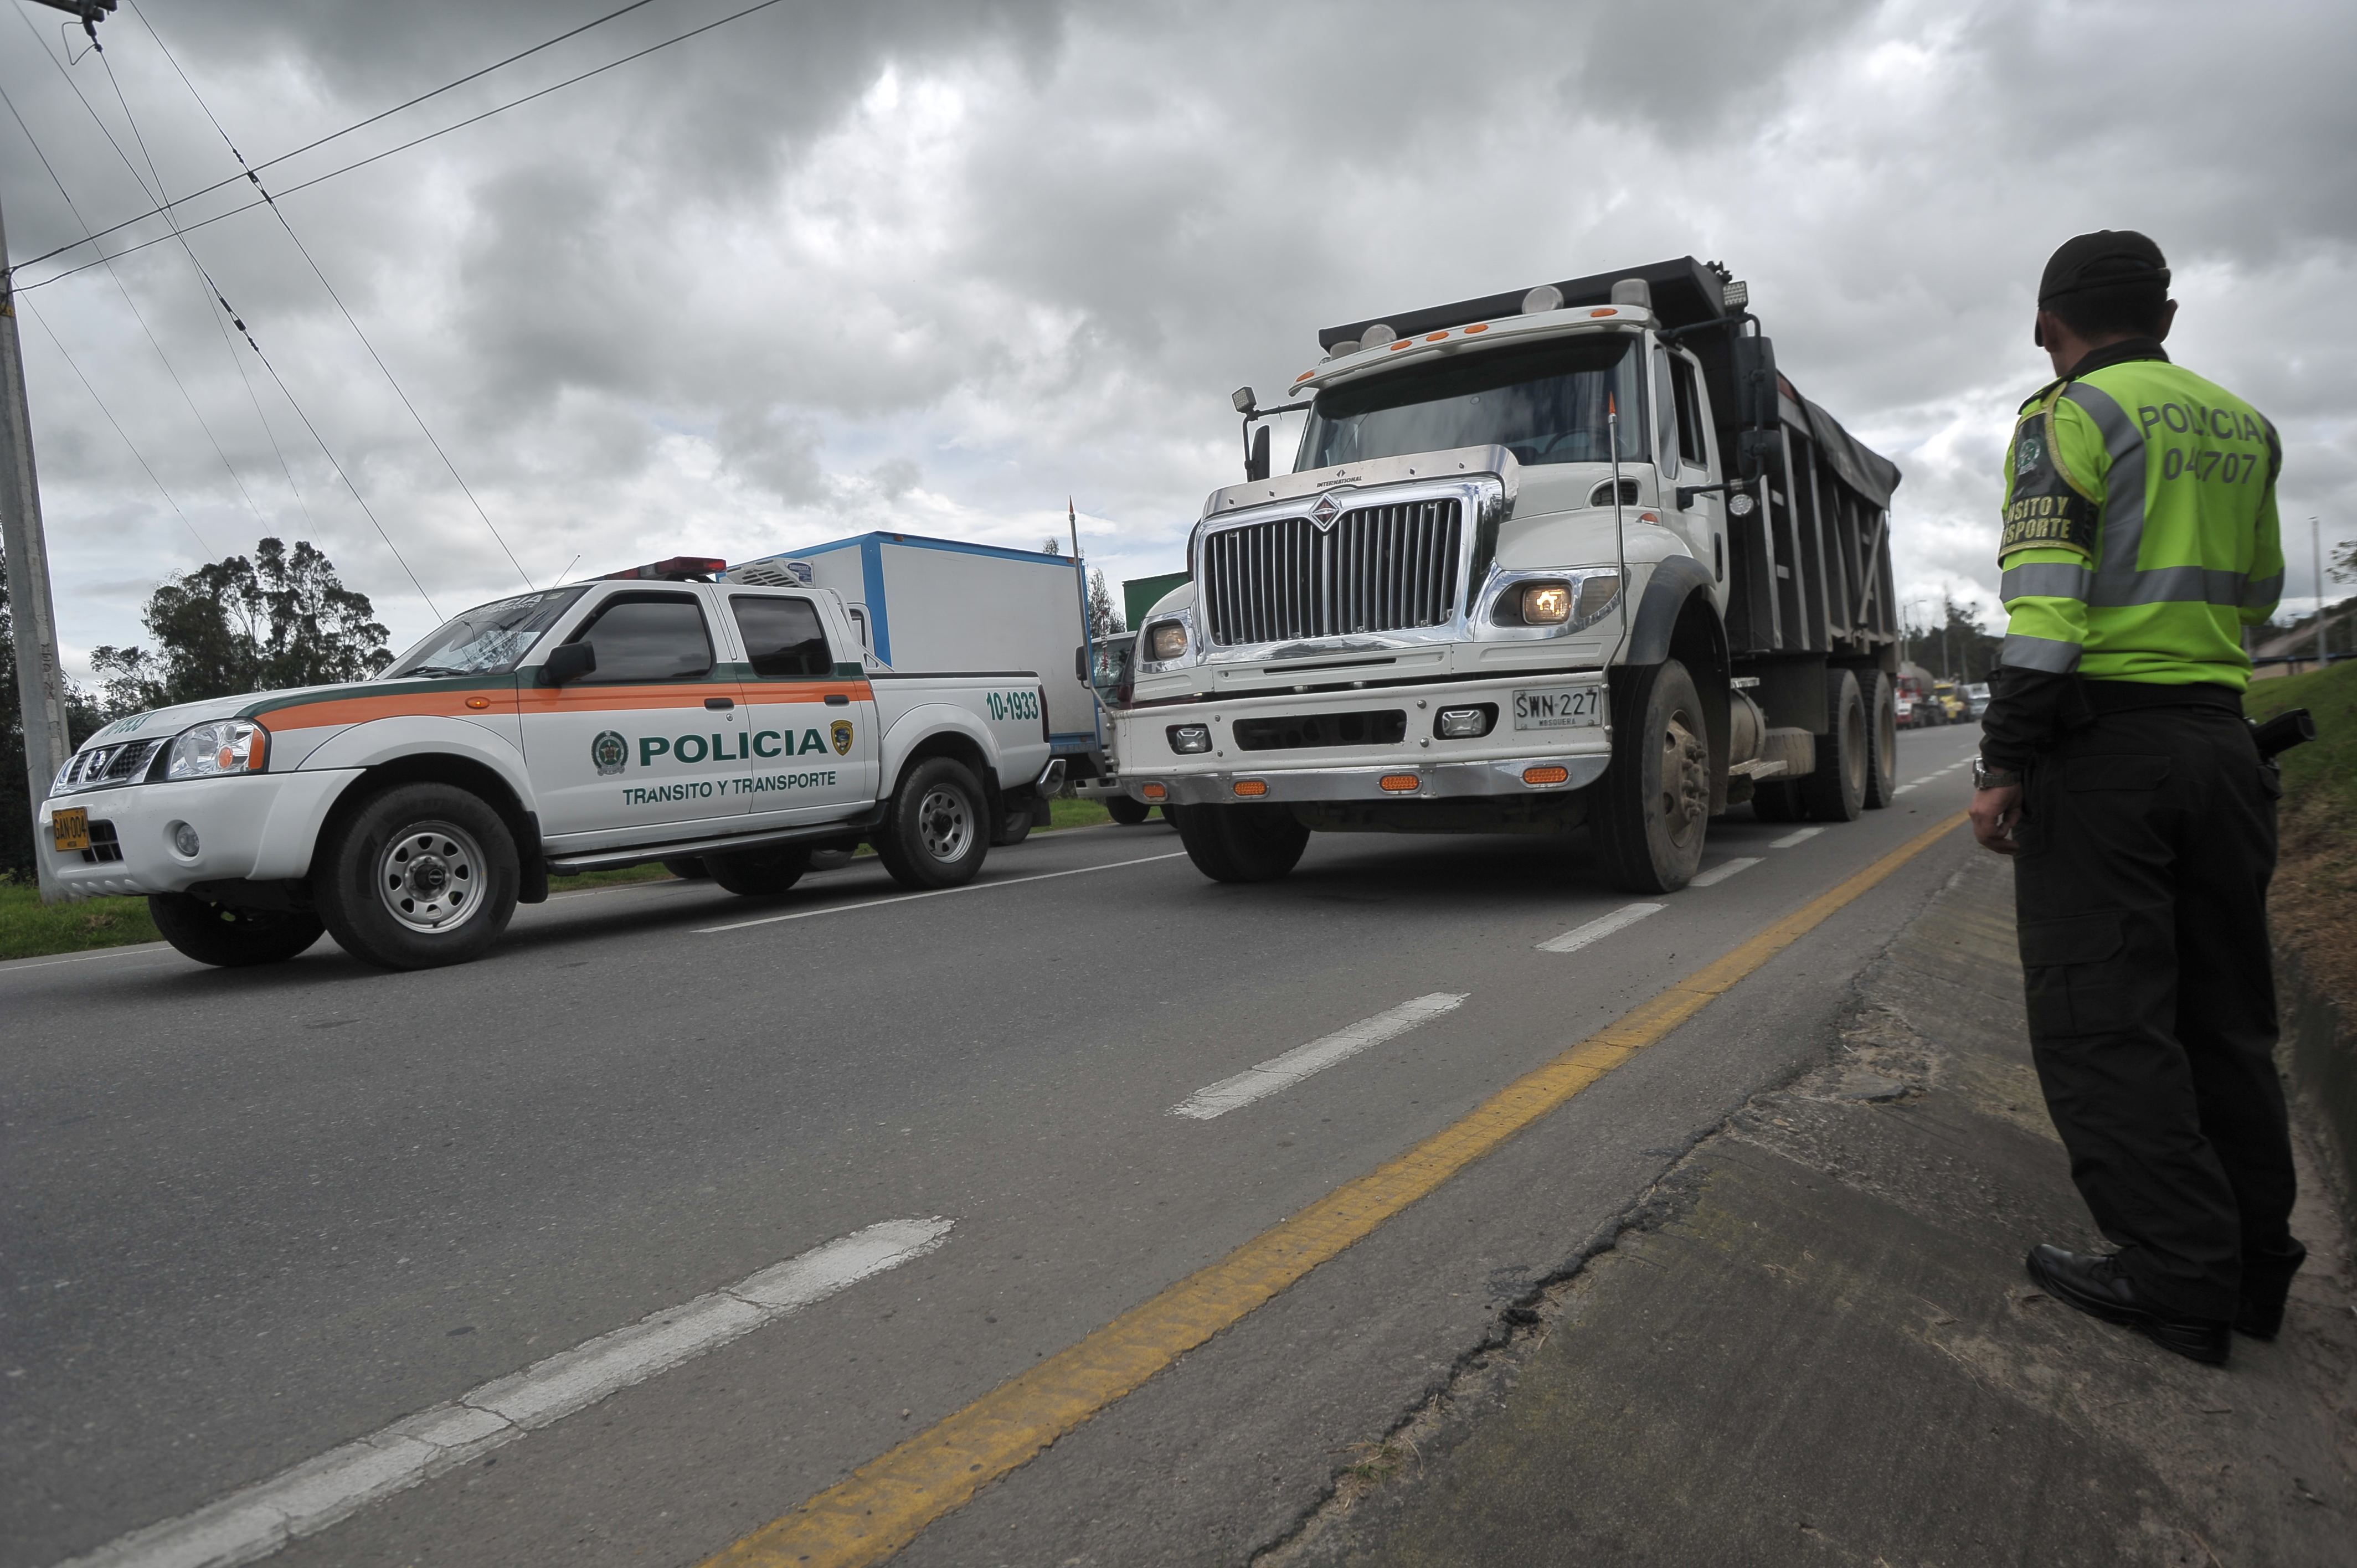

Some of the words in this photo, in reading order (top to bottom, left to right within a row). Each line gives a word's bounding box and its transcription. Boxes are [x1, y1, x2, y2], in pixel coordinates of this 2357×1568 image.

[2138, 403, 2263, 444] POLICIA
[1316, 476, 1362, 488] INTERNATIONAL
[2057, 497, 2069, 515] Y
[986, 691, 1039, 721] 10-1933
[1538, 718, 1576, 726] MOSQUERA
[639, 728, 829, 767] POLICIA
[622, 781, 713, 806] TRANSITO
[716, 780, 728, 796] Y
[732, 770, 837, 795] TRANSPORTE
